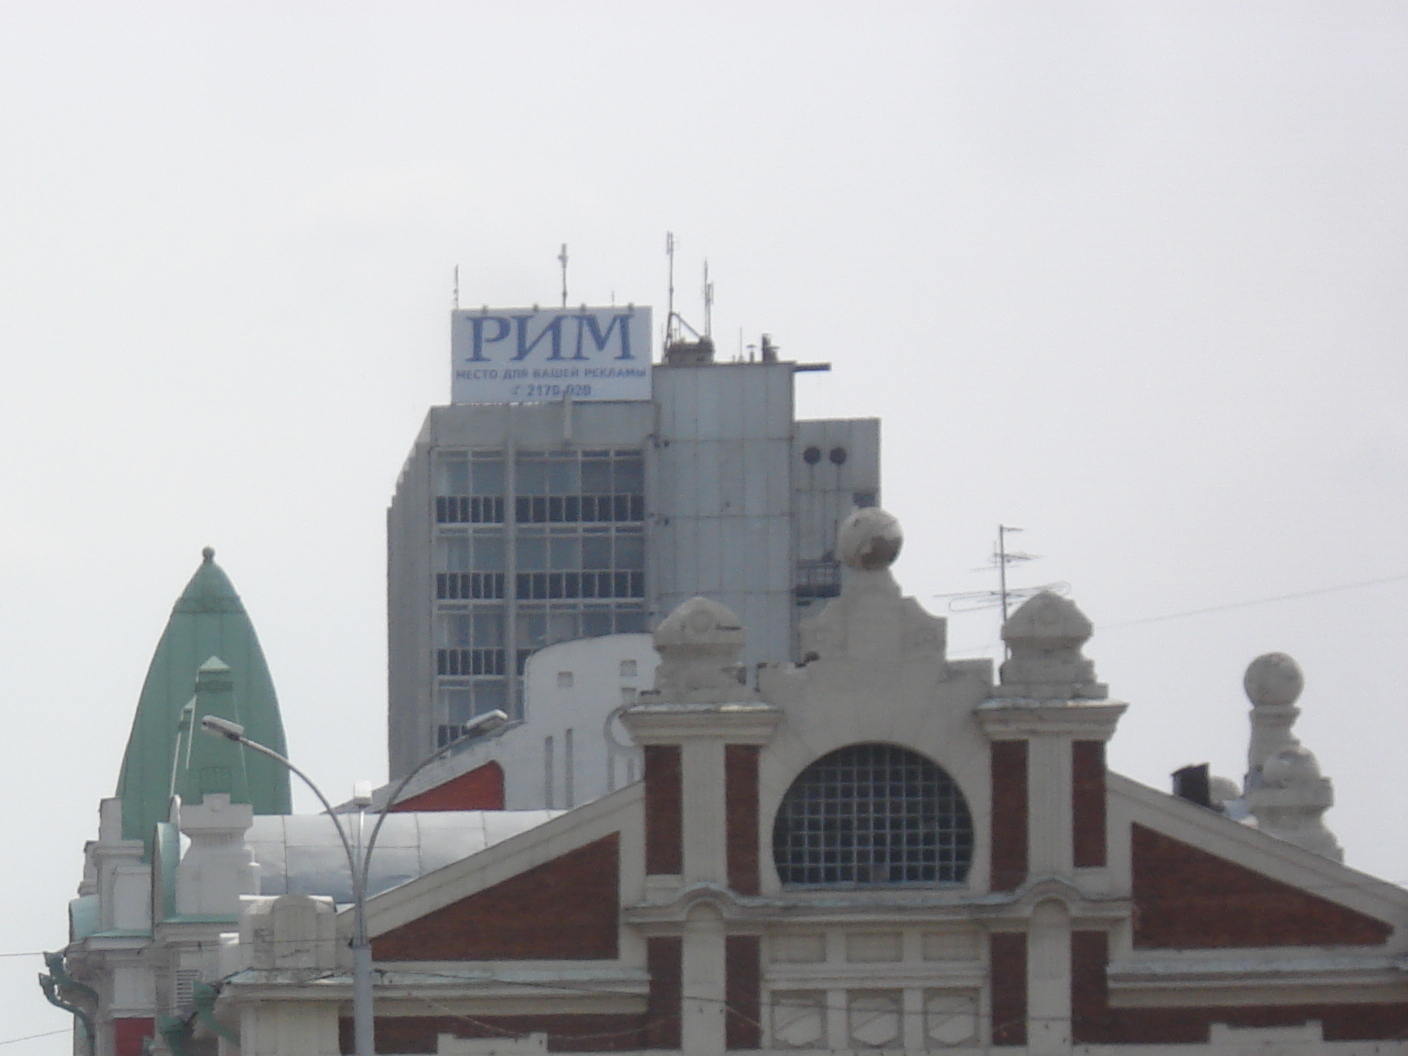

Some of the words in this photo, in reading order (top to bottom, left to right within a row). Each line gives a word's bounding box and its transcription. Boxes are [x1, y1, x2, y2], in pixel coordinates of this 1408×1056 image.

[465, 313, 635, 362] РИМ
[456, 369, 498, 380] МЕСТО
[503, 369, 529, 380] ДЛЯ
[584, 367, 646, 378] РЕКЛАМЫ
